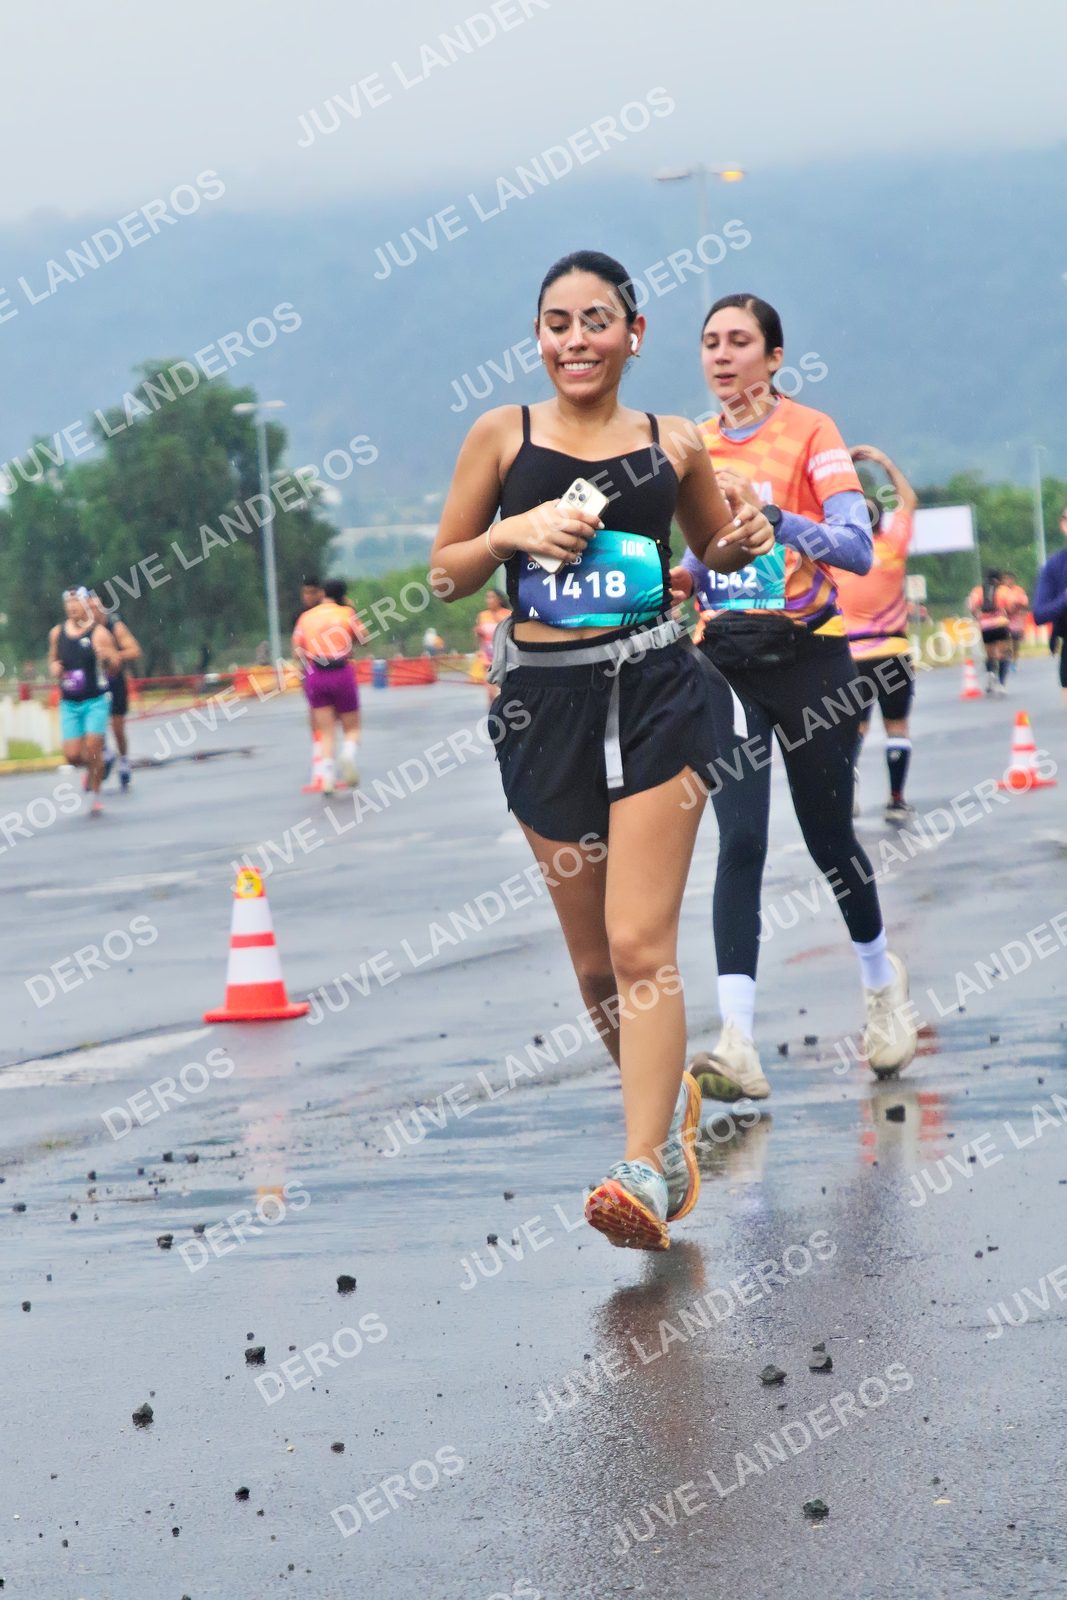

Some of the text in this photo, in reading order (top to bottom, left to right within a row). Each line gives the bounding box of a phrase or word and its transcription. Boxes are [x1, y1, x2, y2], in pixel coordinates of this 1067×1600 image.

[621, 539, 646, 557] 10K
[542, 570, 626, 601] 1418
[708, 566, 757, 590] 1542
